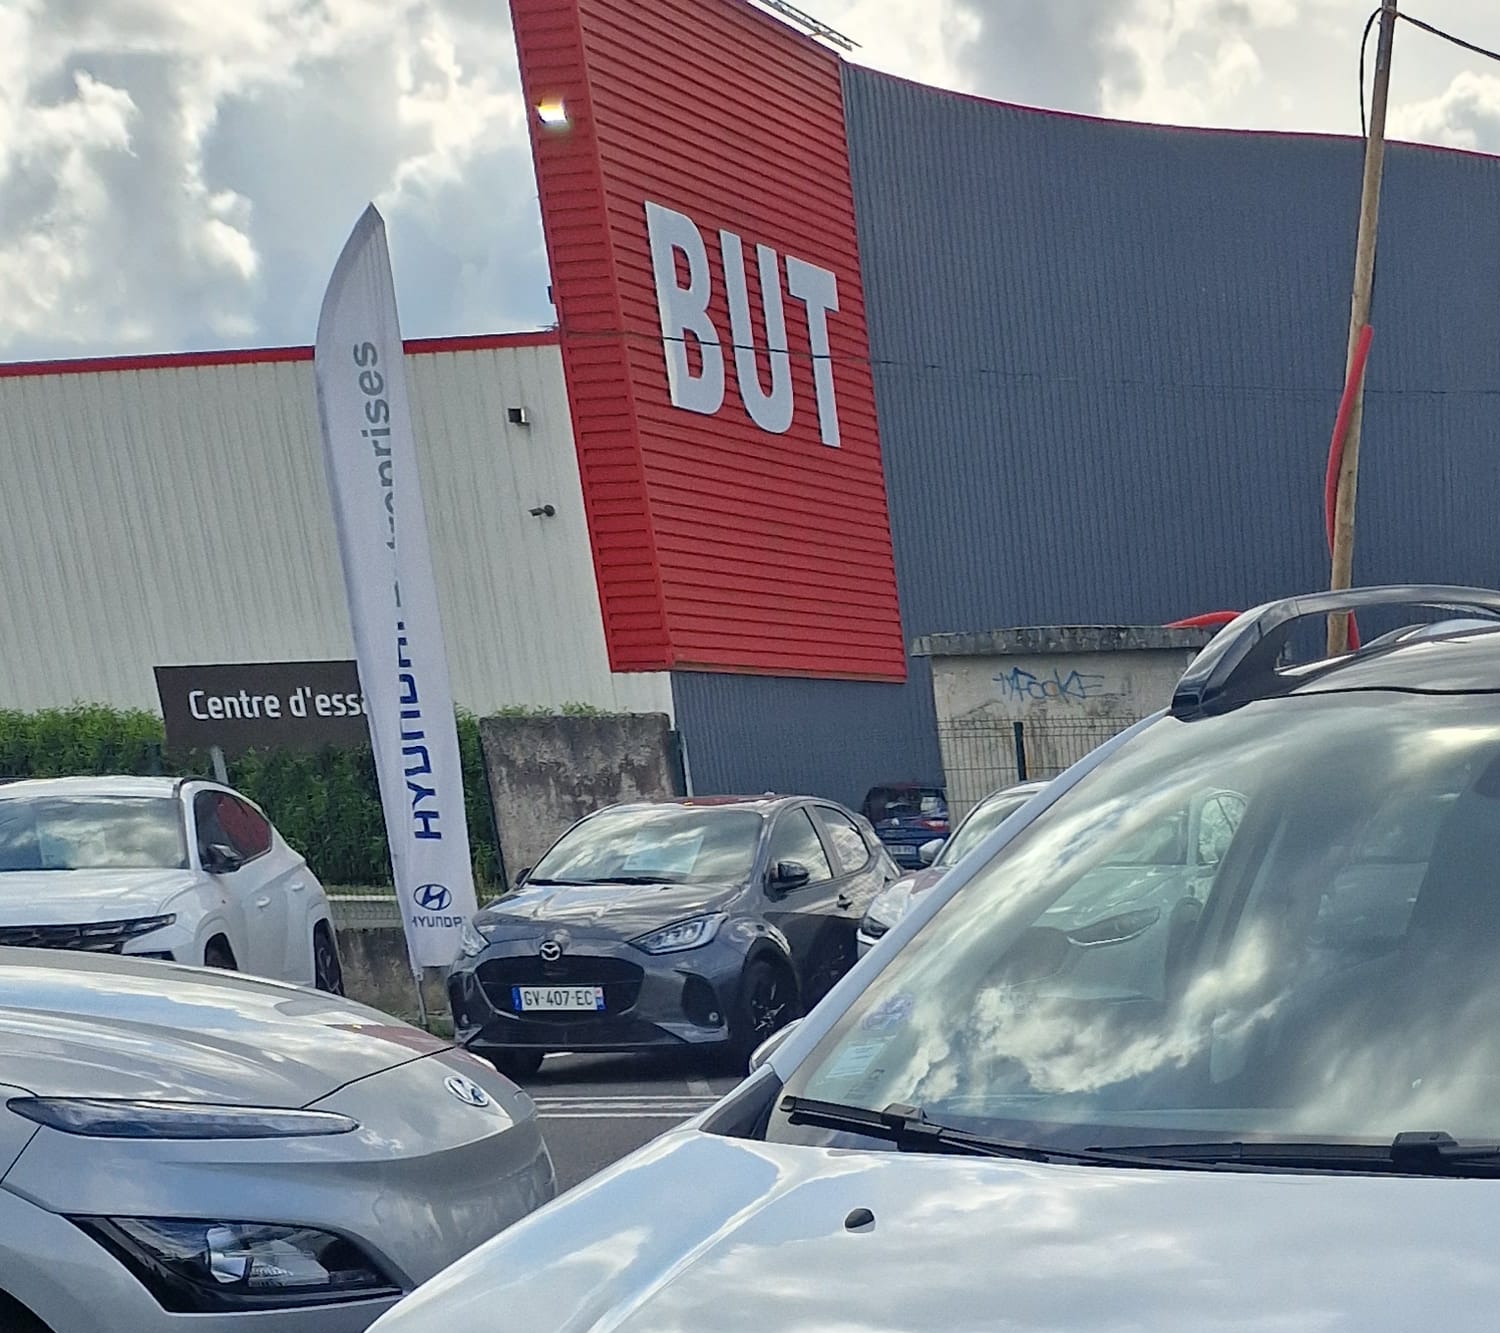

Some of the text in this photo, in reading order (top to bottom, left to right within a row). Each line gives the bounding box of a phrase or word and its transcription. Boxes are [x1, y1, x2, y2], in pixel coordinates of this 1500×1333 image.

[644, 200, 841, 448] BUT
[188, 687, 367, 720] Centre d'ess
